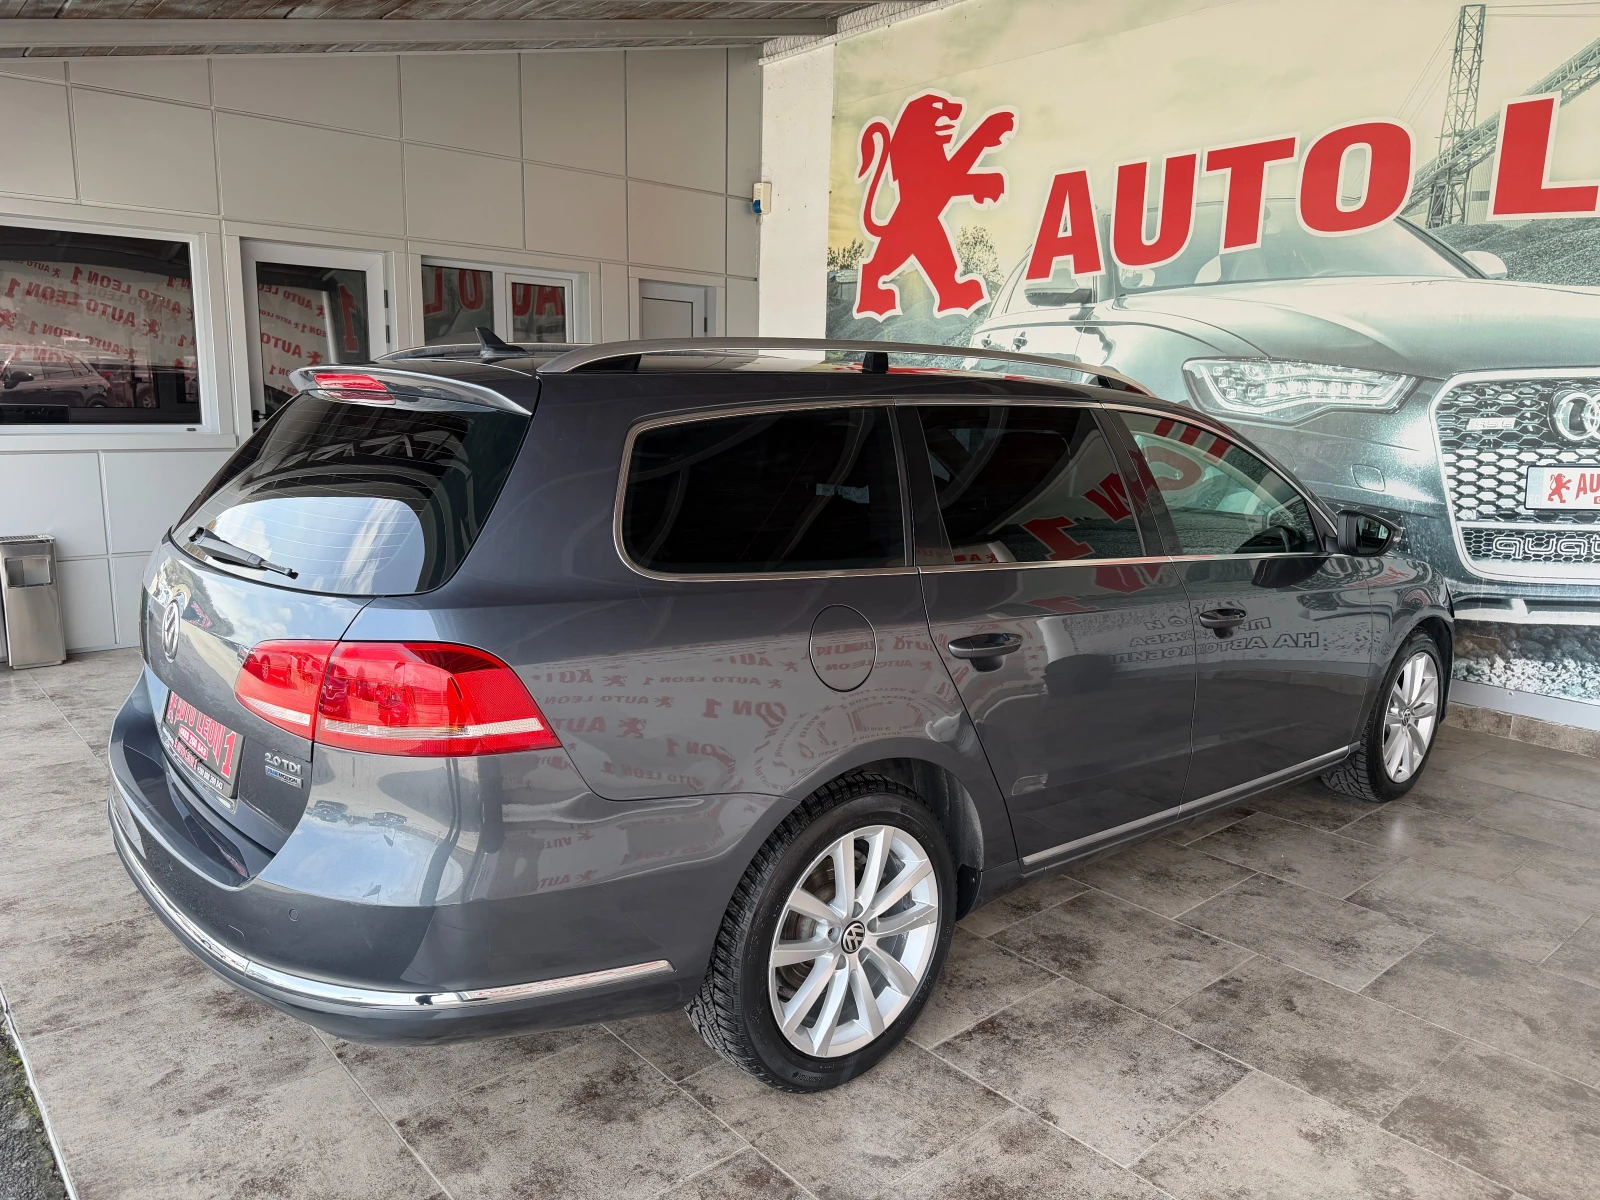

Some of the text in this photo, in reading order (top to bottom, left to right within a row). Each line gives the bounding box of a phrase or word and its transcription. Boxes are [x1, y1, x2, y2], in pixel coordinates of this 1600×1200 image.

[1024, 97, 1600, 282] AUTO L
[221, 730, 237, 779] 1
[281, 758, 302, 776] TDI
